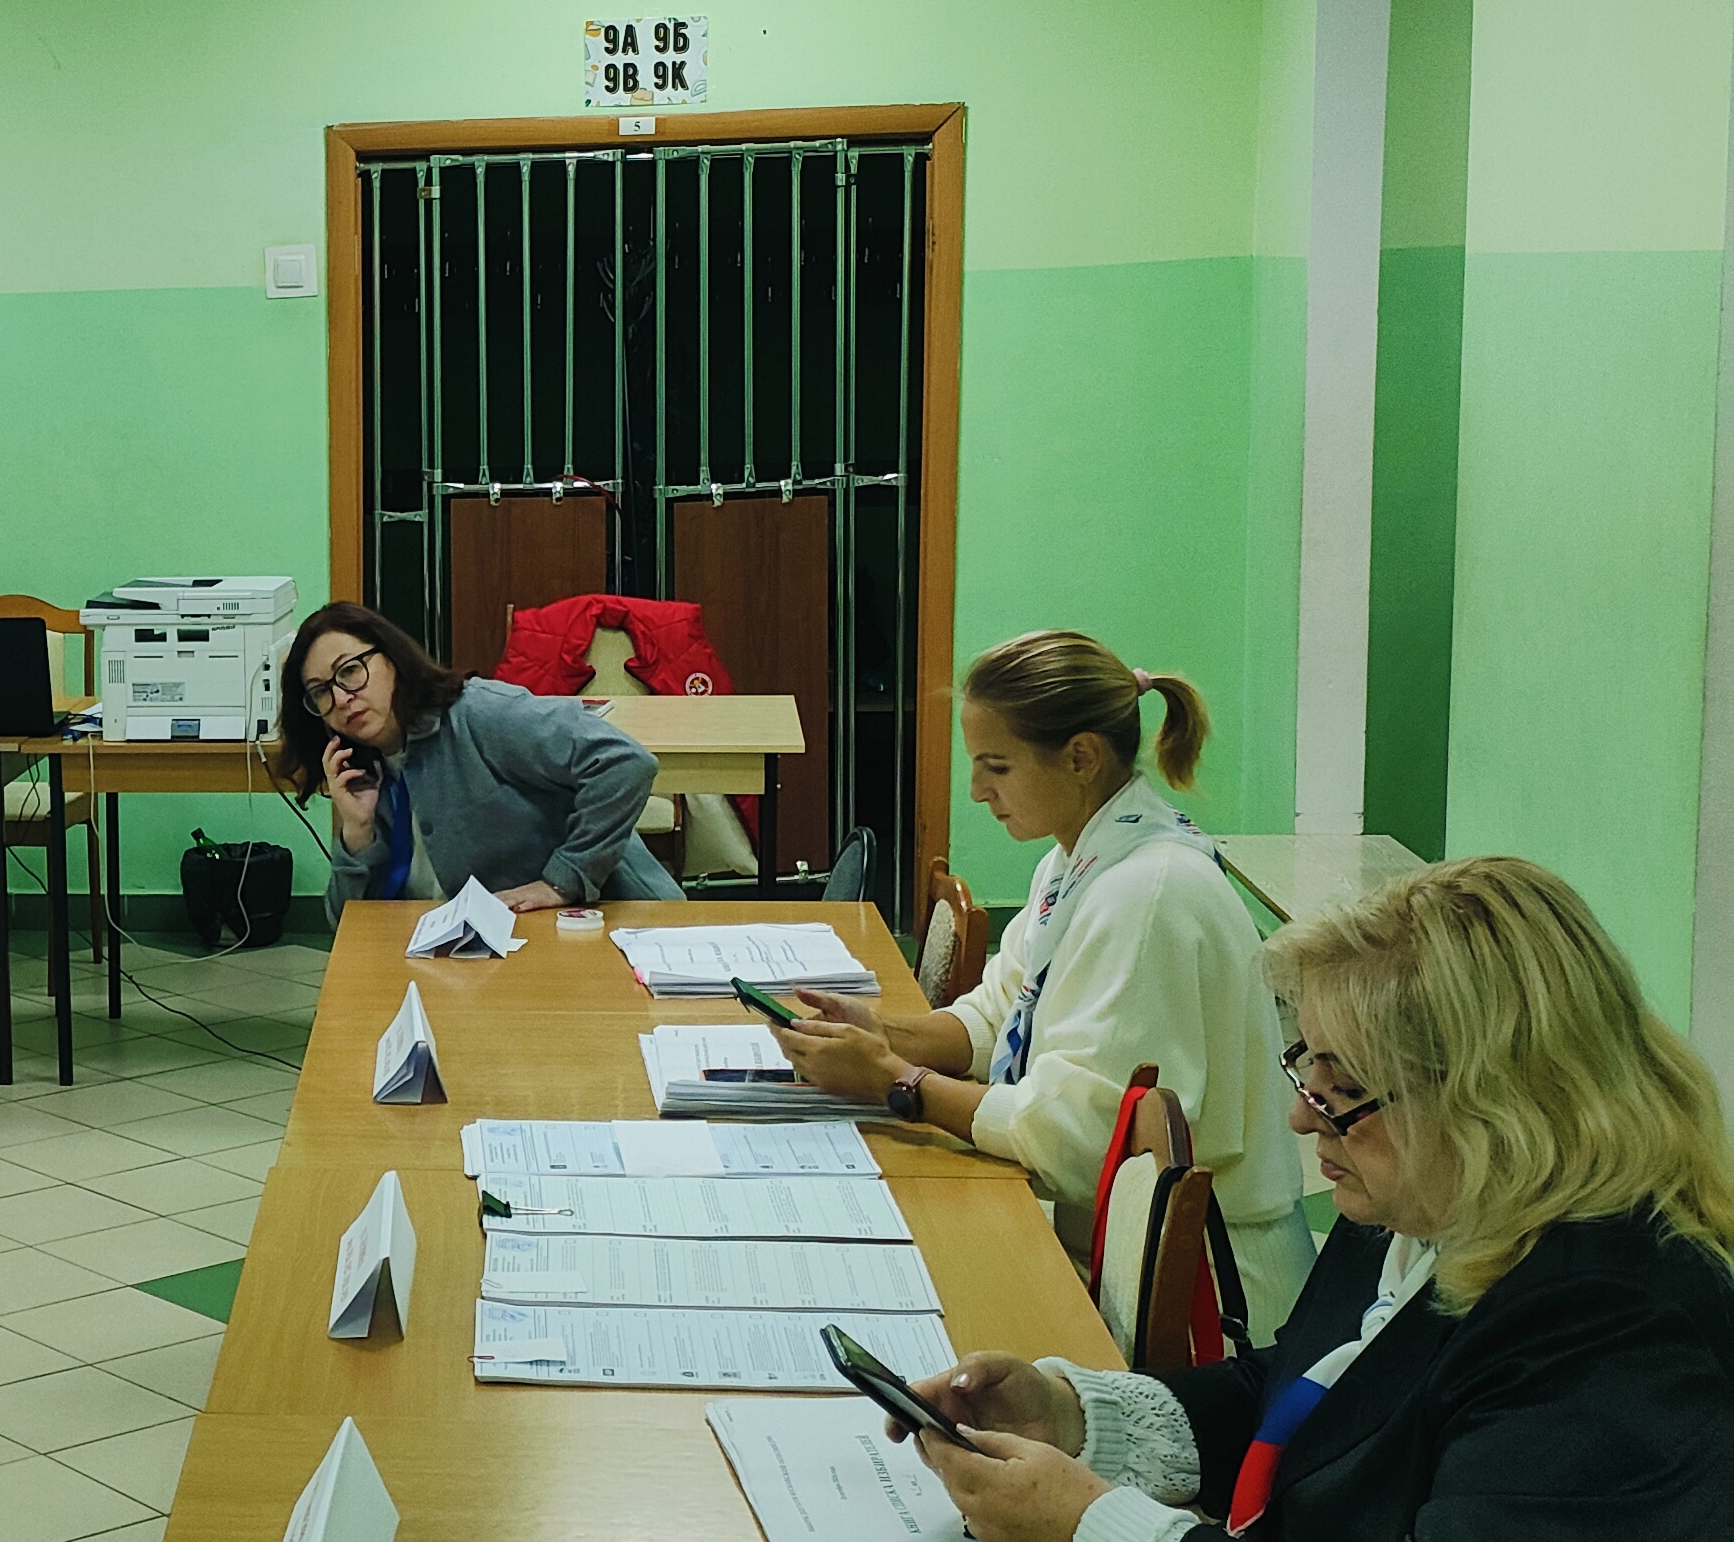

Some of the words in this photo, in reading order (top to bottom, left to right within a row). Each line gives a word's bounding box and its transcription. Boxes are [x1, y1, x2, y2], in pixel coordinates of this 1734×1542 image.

[603, 24, 639, 56] 9А
[653, 21, 690, 54] 9Б
[604, 62, 640, 94] 9В
[653, 60, 689, 91] 9К
[633, 121, 641, 132] 5
